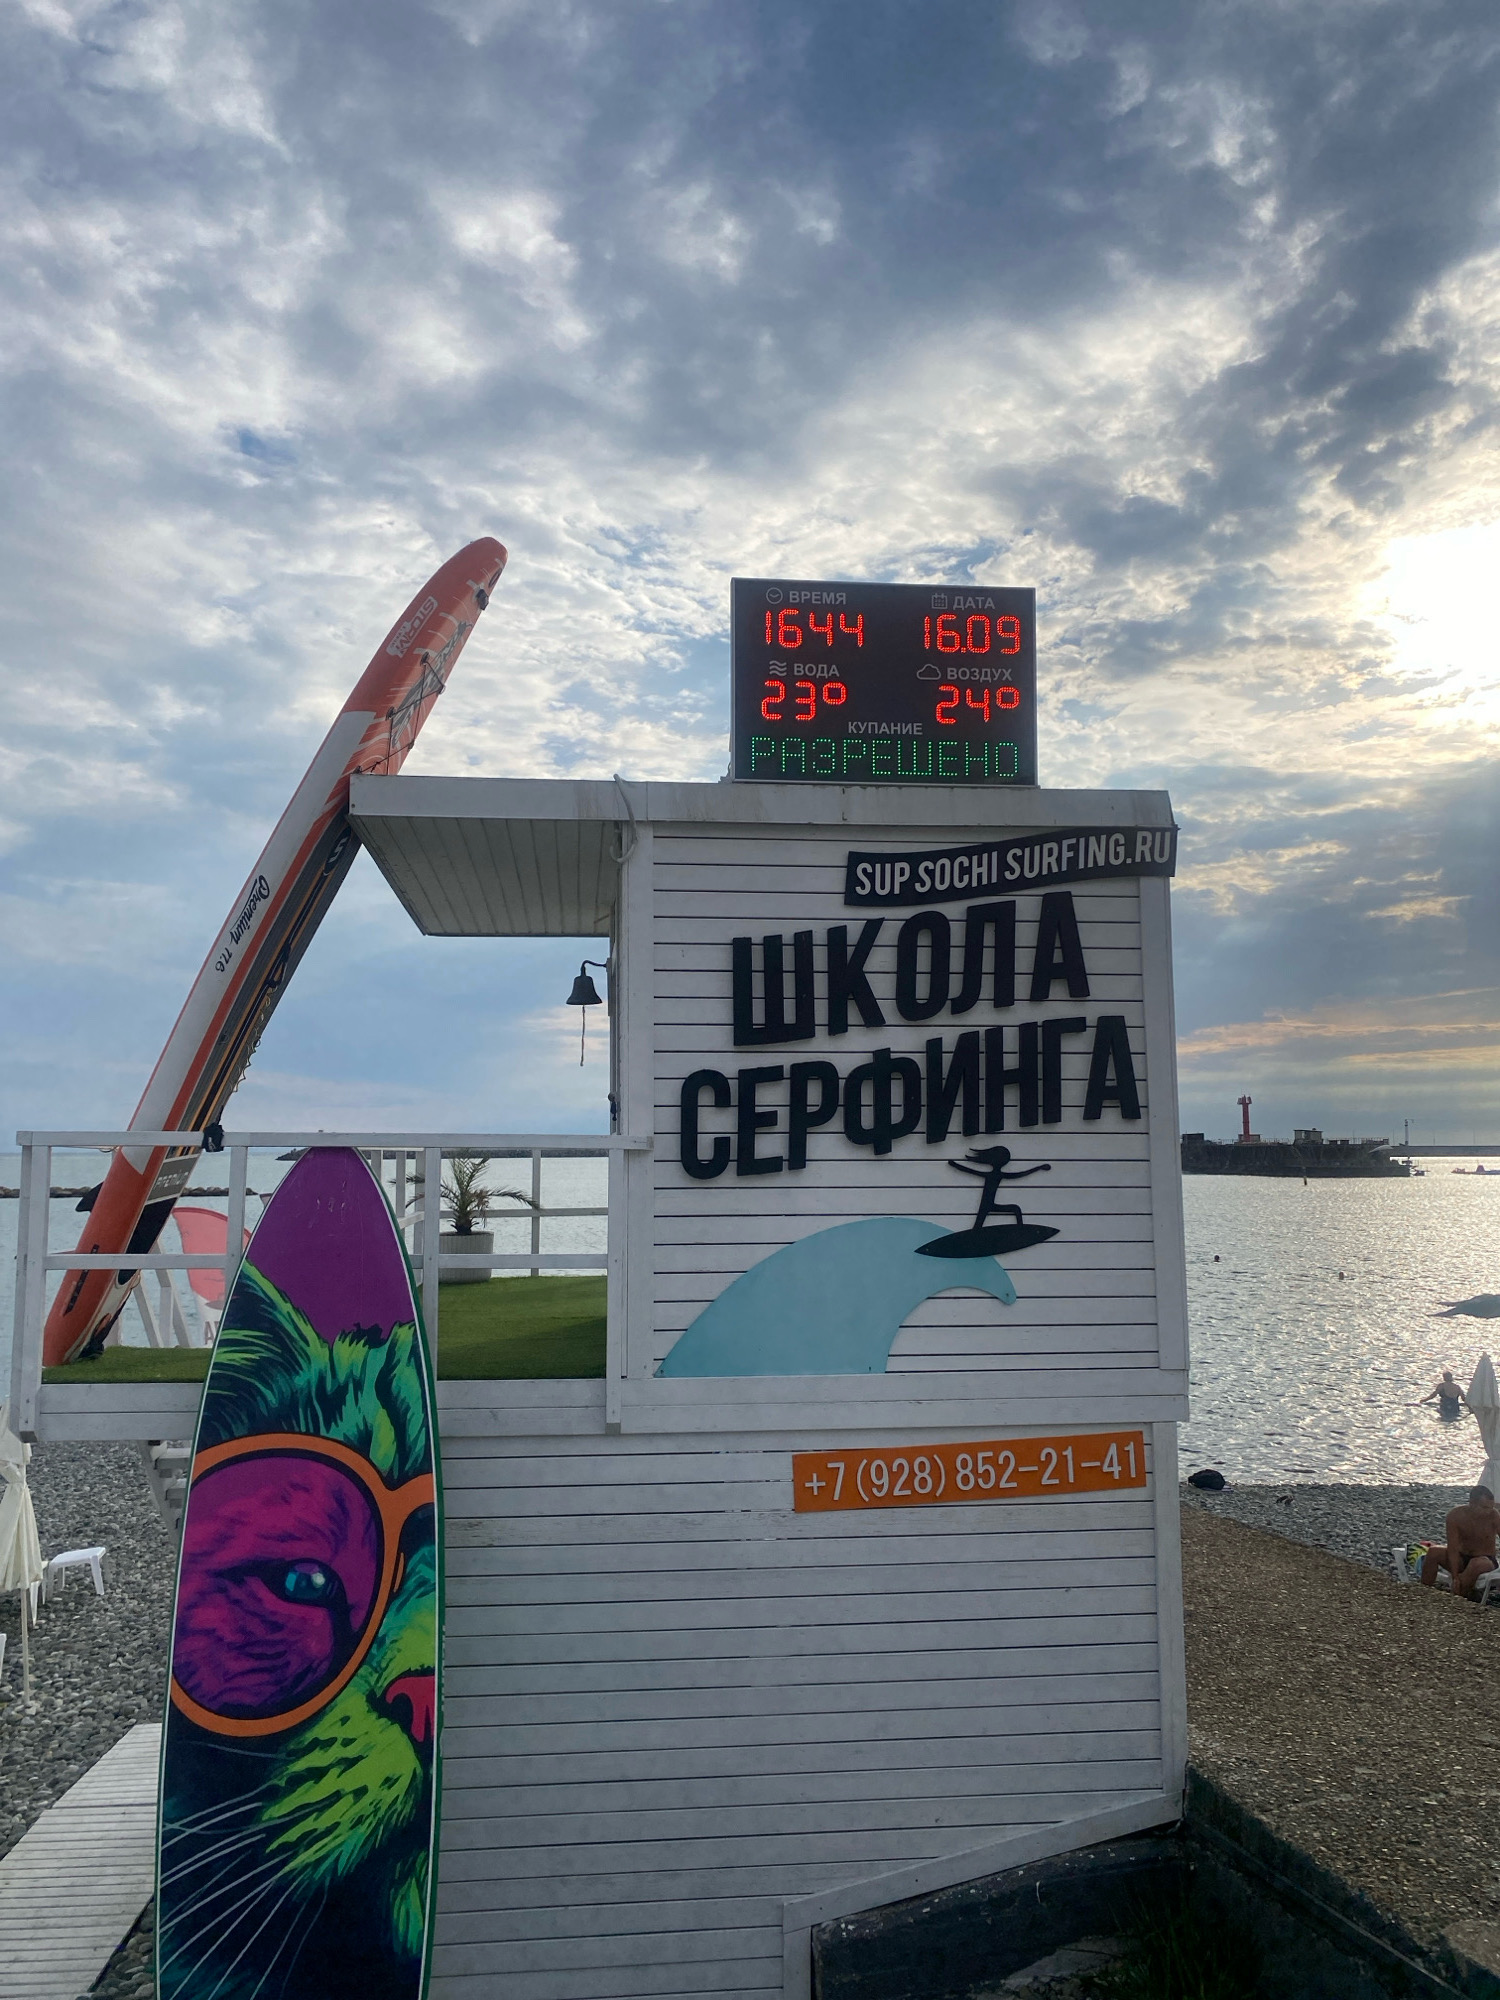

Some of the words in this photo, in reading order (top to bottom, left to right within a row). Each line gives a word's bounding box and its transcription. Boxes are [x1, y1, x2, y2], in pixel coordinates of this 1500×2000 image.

[789, 591, 847, 605] ВРЕМЯ
[952, 596, 996, 610] ДАТА
[923, 613, 1022, 655] 16.09
[793, 663, 840, 678] ВОДА
[946, 667, 1013, 683] ВОЗДУХ
[848, 721, 923, 735] КУПАНИЕ
[750, 736, 1020, 778] РАЗРЕШЕНО
[855, 861, 911, 896] SUP
[914, 850, 999, 893] SOCHI
[1004, 830, 1171, 880] SURFING.RU
[229, 875, 270, 945] Premium
[732, 890, 1091, 1047] ШКОЛА
[680, 1014, 1142, 1180] СЕРФИНГА
[804, 1461, 846, 1501] +7
[856, 1454, 946, 1502] (928)
[955, 1440, 1137, 1491] 852-21-41
